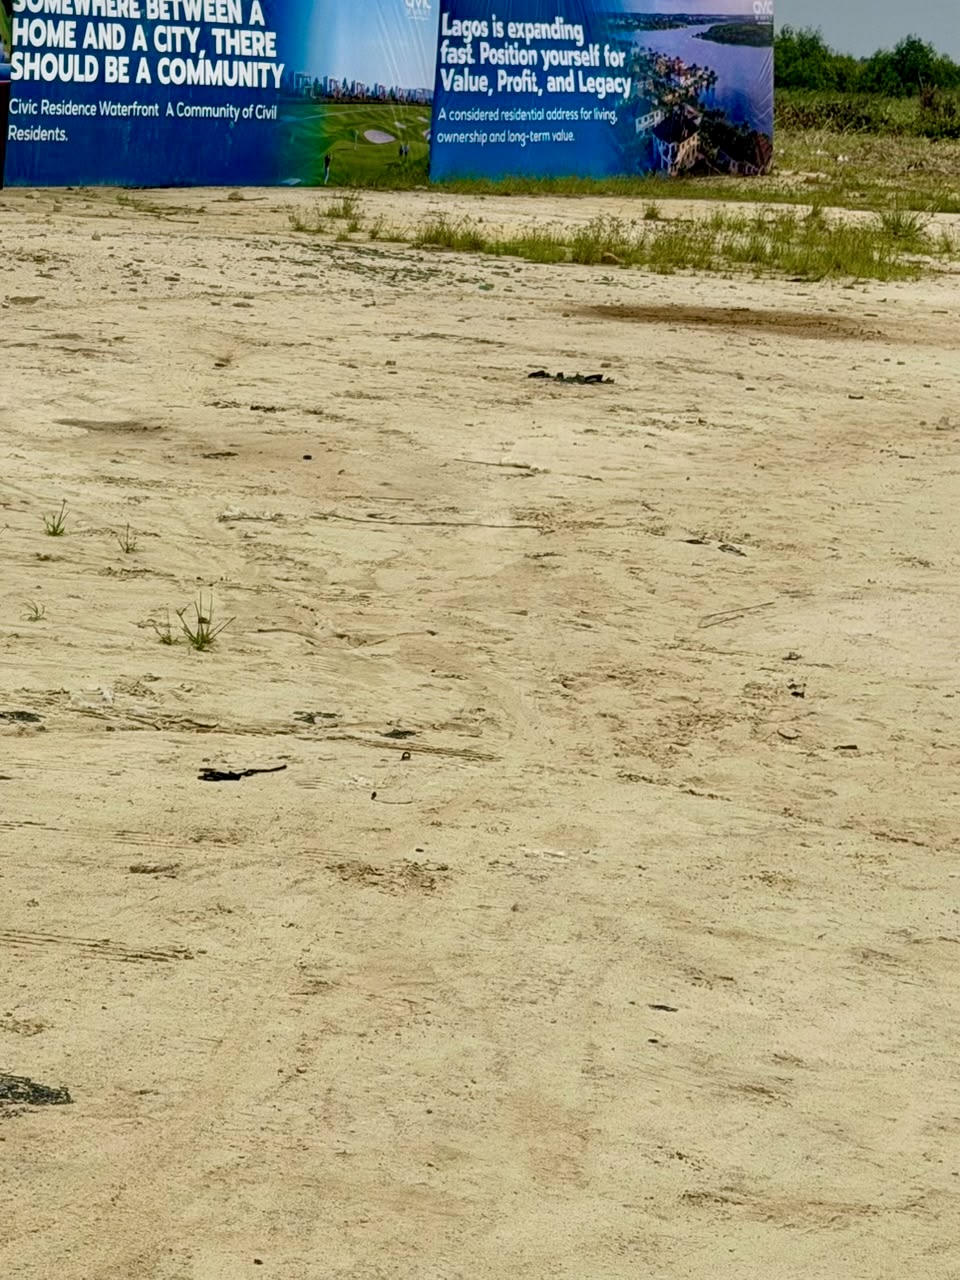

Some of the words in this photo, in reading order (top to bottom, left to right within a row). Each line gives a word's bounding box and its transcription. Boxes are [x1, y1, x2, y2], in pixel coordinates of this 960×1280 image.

[248, 0, 265, 26] A
[12, 17, 76, 48] HOME
[82, 22, 126, 50] AND
[132, 24, 148, 52] A
[154, 25, 206, 58] CITY,
[211, 28, 277, 58] THERE
[442, 12, 488, 44] Lagos
[492, 14, 504, 38] is
[508, 16, 584, 46] expanding
[10, 51, 98, 82] SHOULD
[104, 55, 130, 84] BE
[136, 56, 152, 84] A
[157, 57, 284, 88] COMMUNITY
[440, 40, 476, 64] fast.
[480, 41, 538, 66] Position
[541, 44, 600, 71] yourself
[604, 44, 626, 68] for
[440, 67, 493, 96] Value,
[497, 68, 543, 96] Profit,
[547, 68, 574, 92] and
[578, 70, 632, 100] Legacy
[8, 98, 38, 116] Civic
[41, 98, 96, 116] Residence
[99, 100, 159, 117] Waterfront
[166, 102, 174, 116] A
[176, 102, 240, 122] Community
[242, 104, 254, 118] of
[255, 104, 277, 120] Civil
[438, 107, 446, 120] A
[449, 108, 499, 120] considered
[501, 108, 544, 120] residential
[546, 108, 578, 120] address
[580, 108, 592, 120] for
[594, 108, 618, 125] living,
[8, 124, 68, 142] Residents.
[436, 130, 488, 146] ownership
[490, 130, 506, 142] and
[508, 130, 550, 147] long-term
[552, 128, 575, 142] value.
